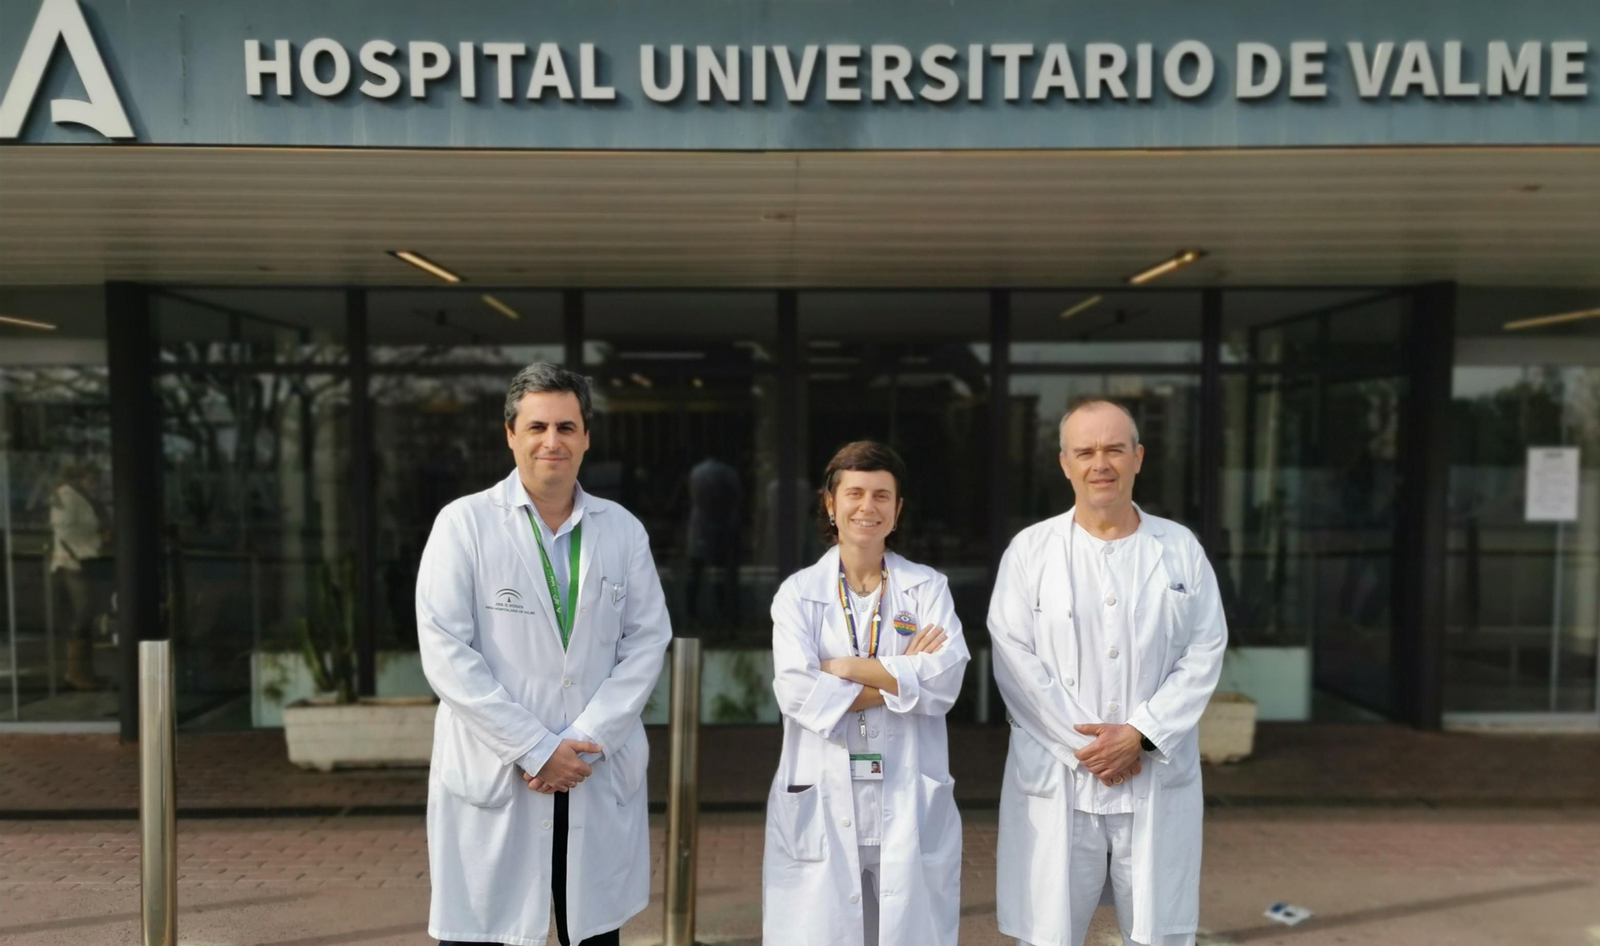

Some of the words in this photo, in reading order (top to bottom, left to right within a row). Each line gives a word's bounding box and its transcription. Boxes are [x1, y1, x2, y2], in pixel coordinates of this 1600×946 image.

[244, 37, 616, 100] HOSPITAL
[640, 40, 1214, 102] UNIVERSITARIO
[1236, 41, 1327, 97] DE
[1348, 40, 1588, 98] VALME
